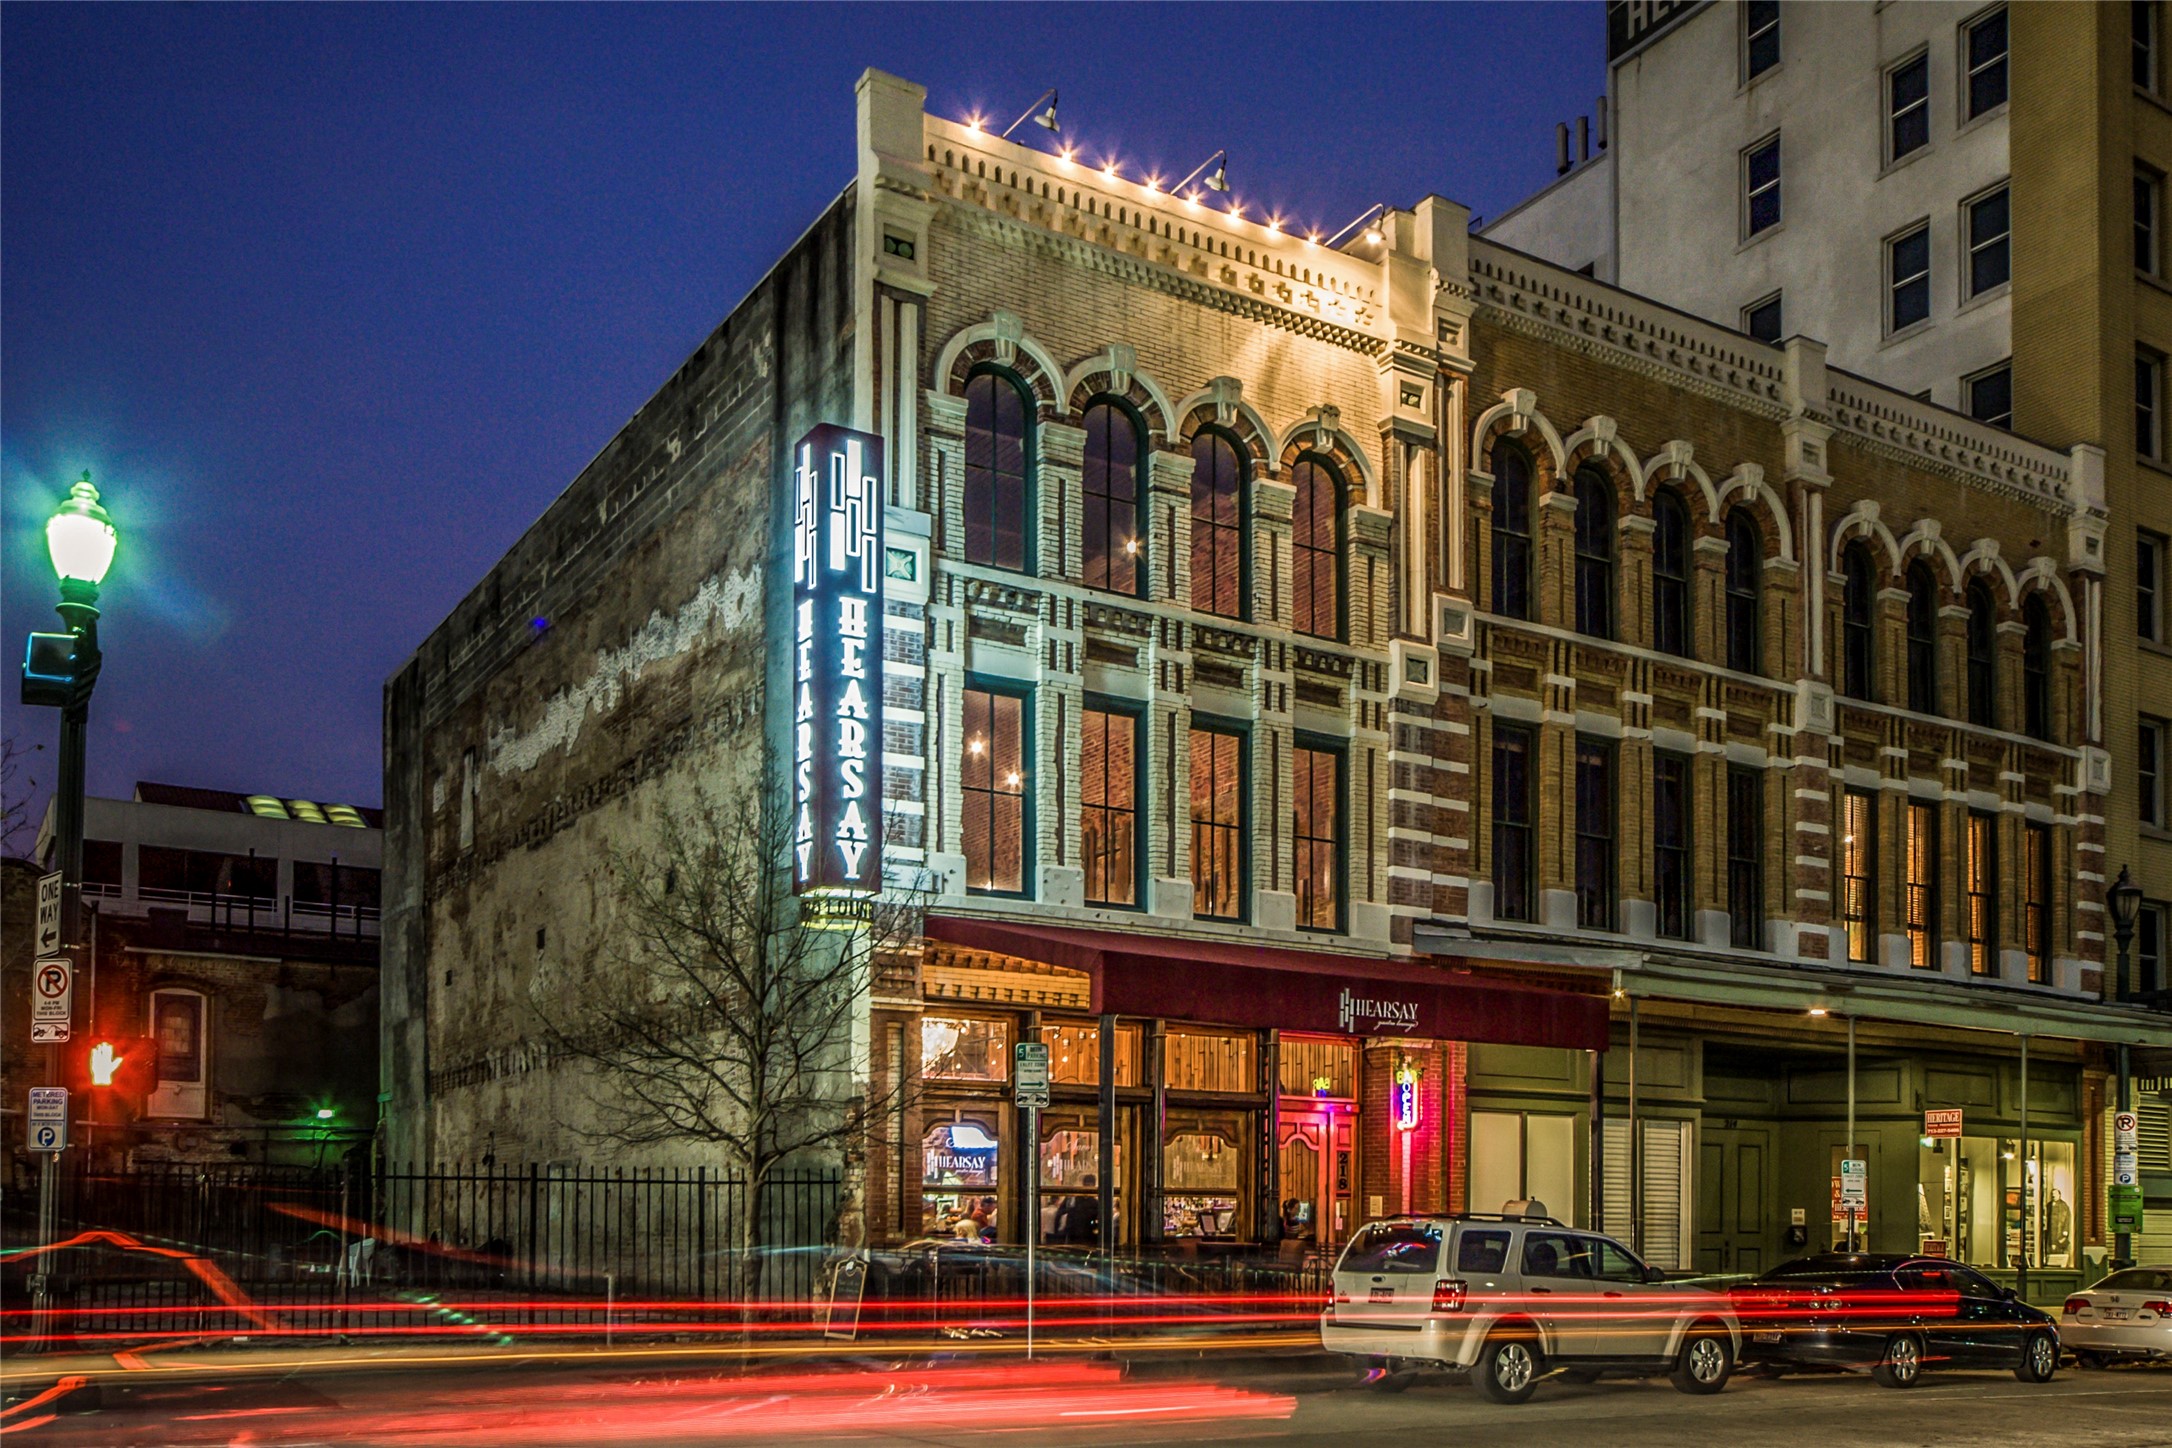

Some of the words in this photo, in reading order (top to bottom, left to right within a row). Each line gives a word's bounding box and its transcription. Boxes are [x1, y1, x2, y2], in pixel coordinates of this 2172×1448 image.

[797, 598, 814, 882] HEARSAY
[836, 595, 869, 880] HEARSAY
[41, 880, 59, 902] ONE
[40, 902, 59, 925] WAY
[1356, 999, 1419, 1021] HEARSAY
[1018, 1048, 1024, 1058] 5
[1401, 1082, 1412, 1125] OPEN
[1927, 1112, 1960, 1123] HERITAGE
[938, 1155, 986, 1169] HEARSAY
[1338, 1152, 1348, 1189] 218
[1844, 1163, 1849, 1171] 5
